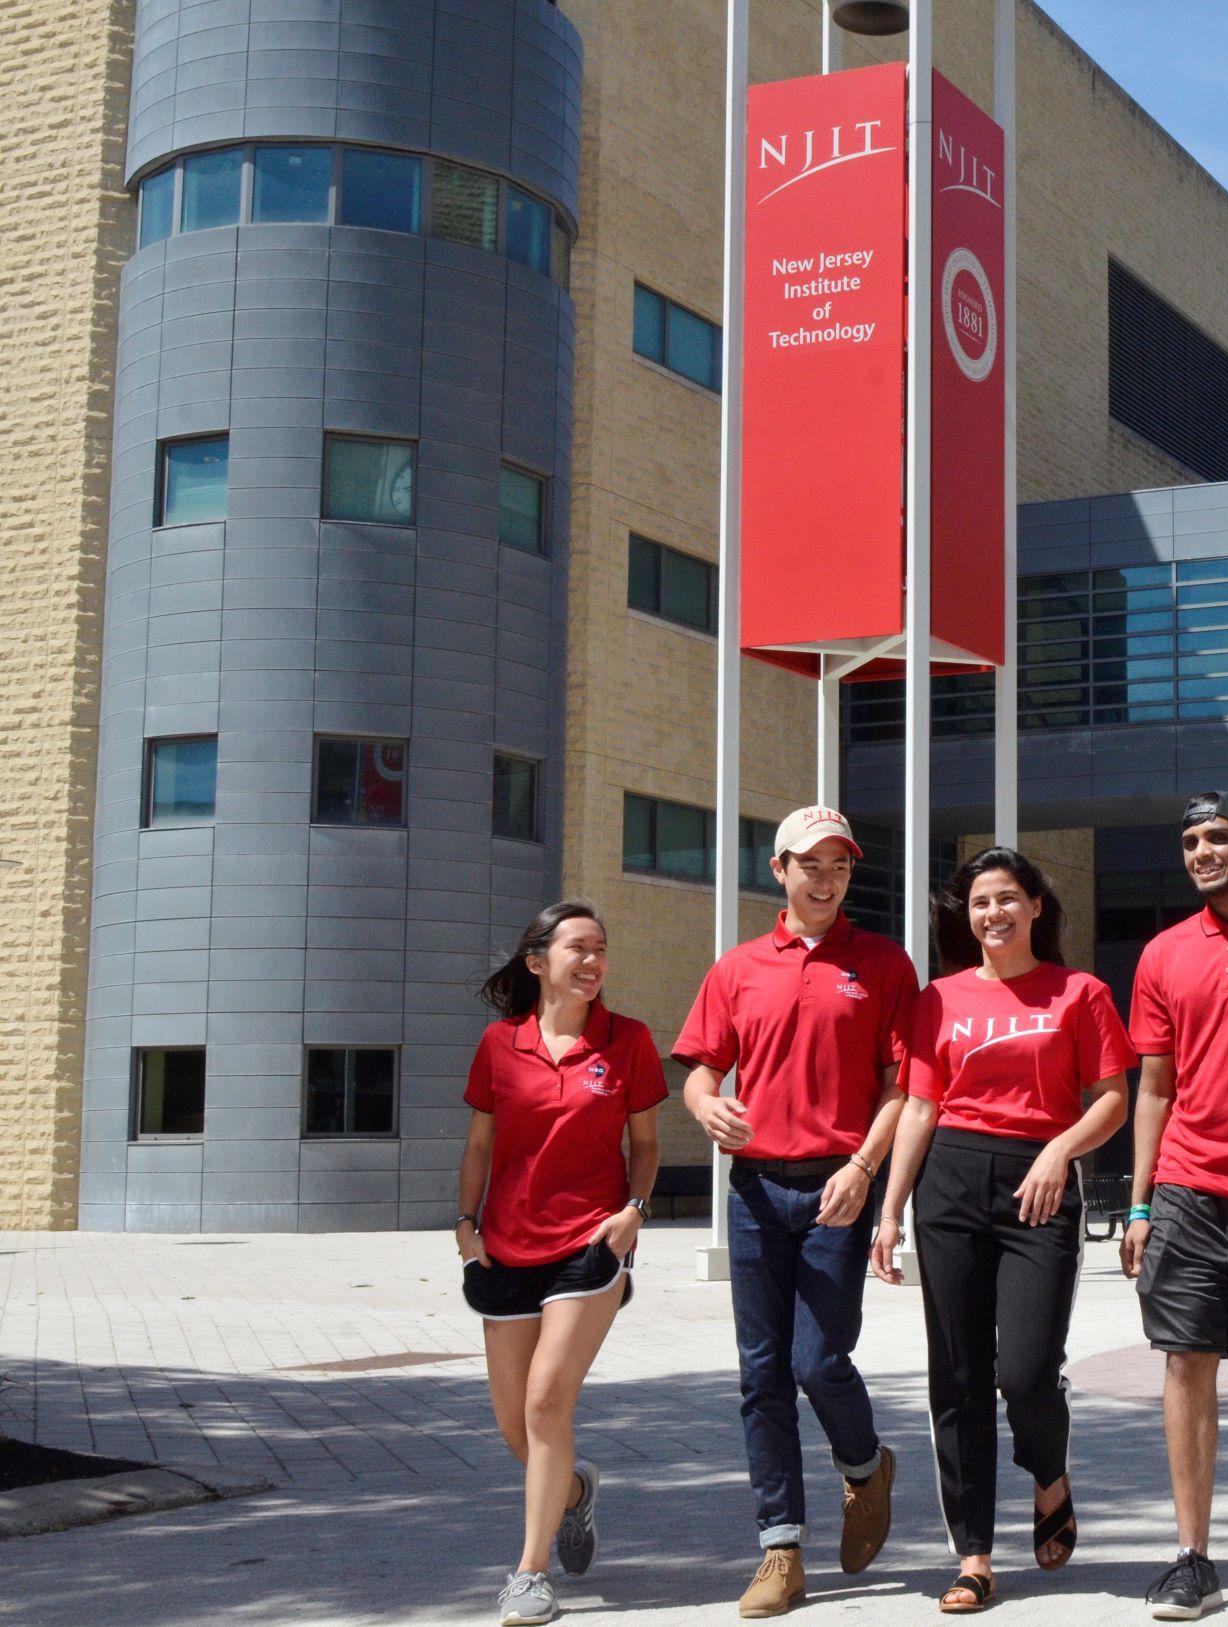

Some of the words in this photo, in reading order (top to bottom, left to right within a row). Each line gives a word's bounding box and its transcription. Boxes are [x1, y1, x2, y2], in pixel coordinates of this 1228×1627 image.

[759, 120, 881, 171] NJIT
[939, 128, 995, 198] NJIT
[772, 258, 813, 276] New
[819, 249, 874, 272] Jersey
[784, 276, 861, 299] Institute
[812, 302, 832, 320] of
[958, 302, 983, 338] 1881
[769, 322, 876, 348] Technology
[804, 811, 847, 823] NJIT
[951, 1013, 1052, 1043] NJIT
